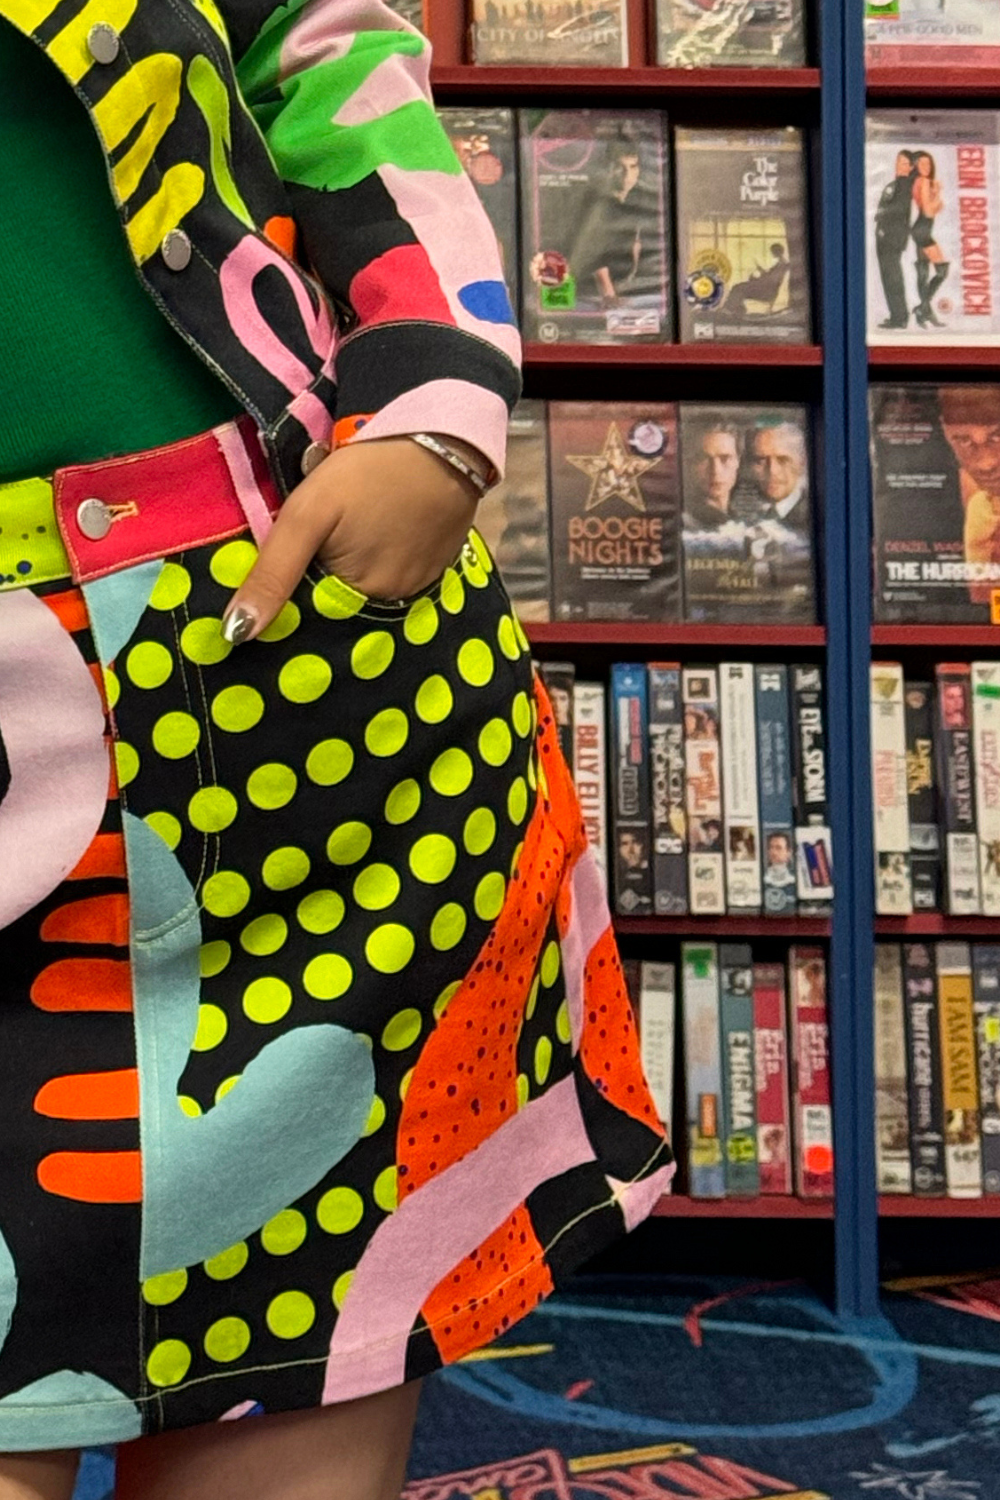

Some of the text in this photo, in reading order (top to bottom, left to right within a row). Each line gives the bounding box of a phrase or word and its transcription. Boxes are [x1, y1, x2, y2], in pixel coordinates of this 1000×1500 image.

[477, 28, 517, 42] CITY
[753, 157, 778, 173] The
[957, 145, 987, 189] ERIN
[959, 197, 992, 316] BROCKOVICH
[568, 516, 663, 540] BOOGIE
[568, 540, 663, 566] NIGHTS
[885, 562, 920, 581] THE
[577, 724, 600, 774] BILLY
[803, 748, 826, 803] STORM
[947, 1007, 968, 1044] AM
[728, 1031, 753, 1131] ENIGMA
[949, 1047, 971, 1094] SAM
